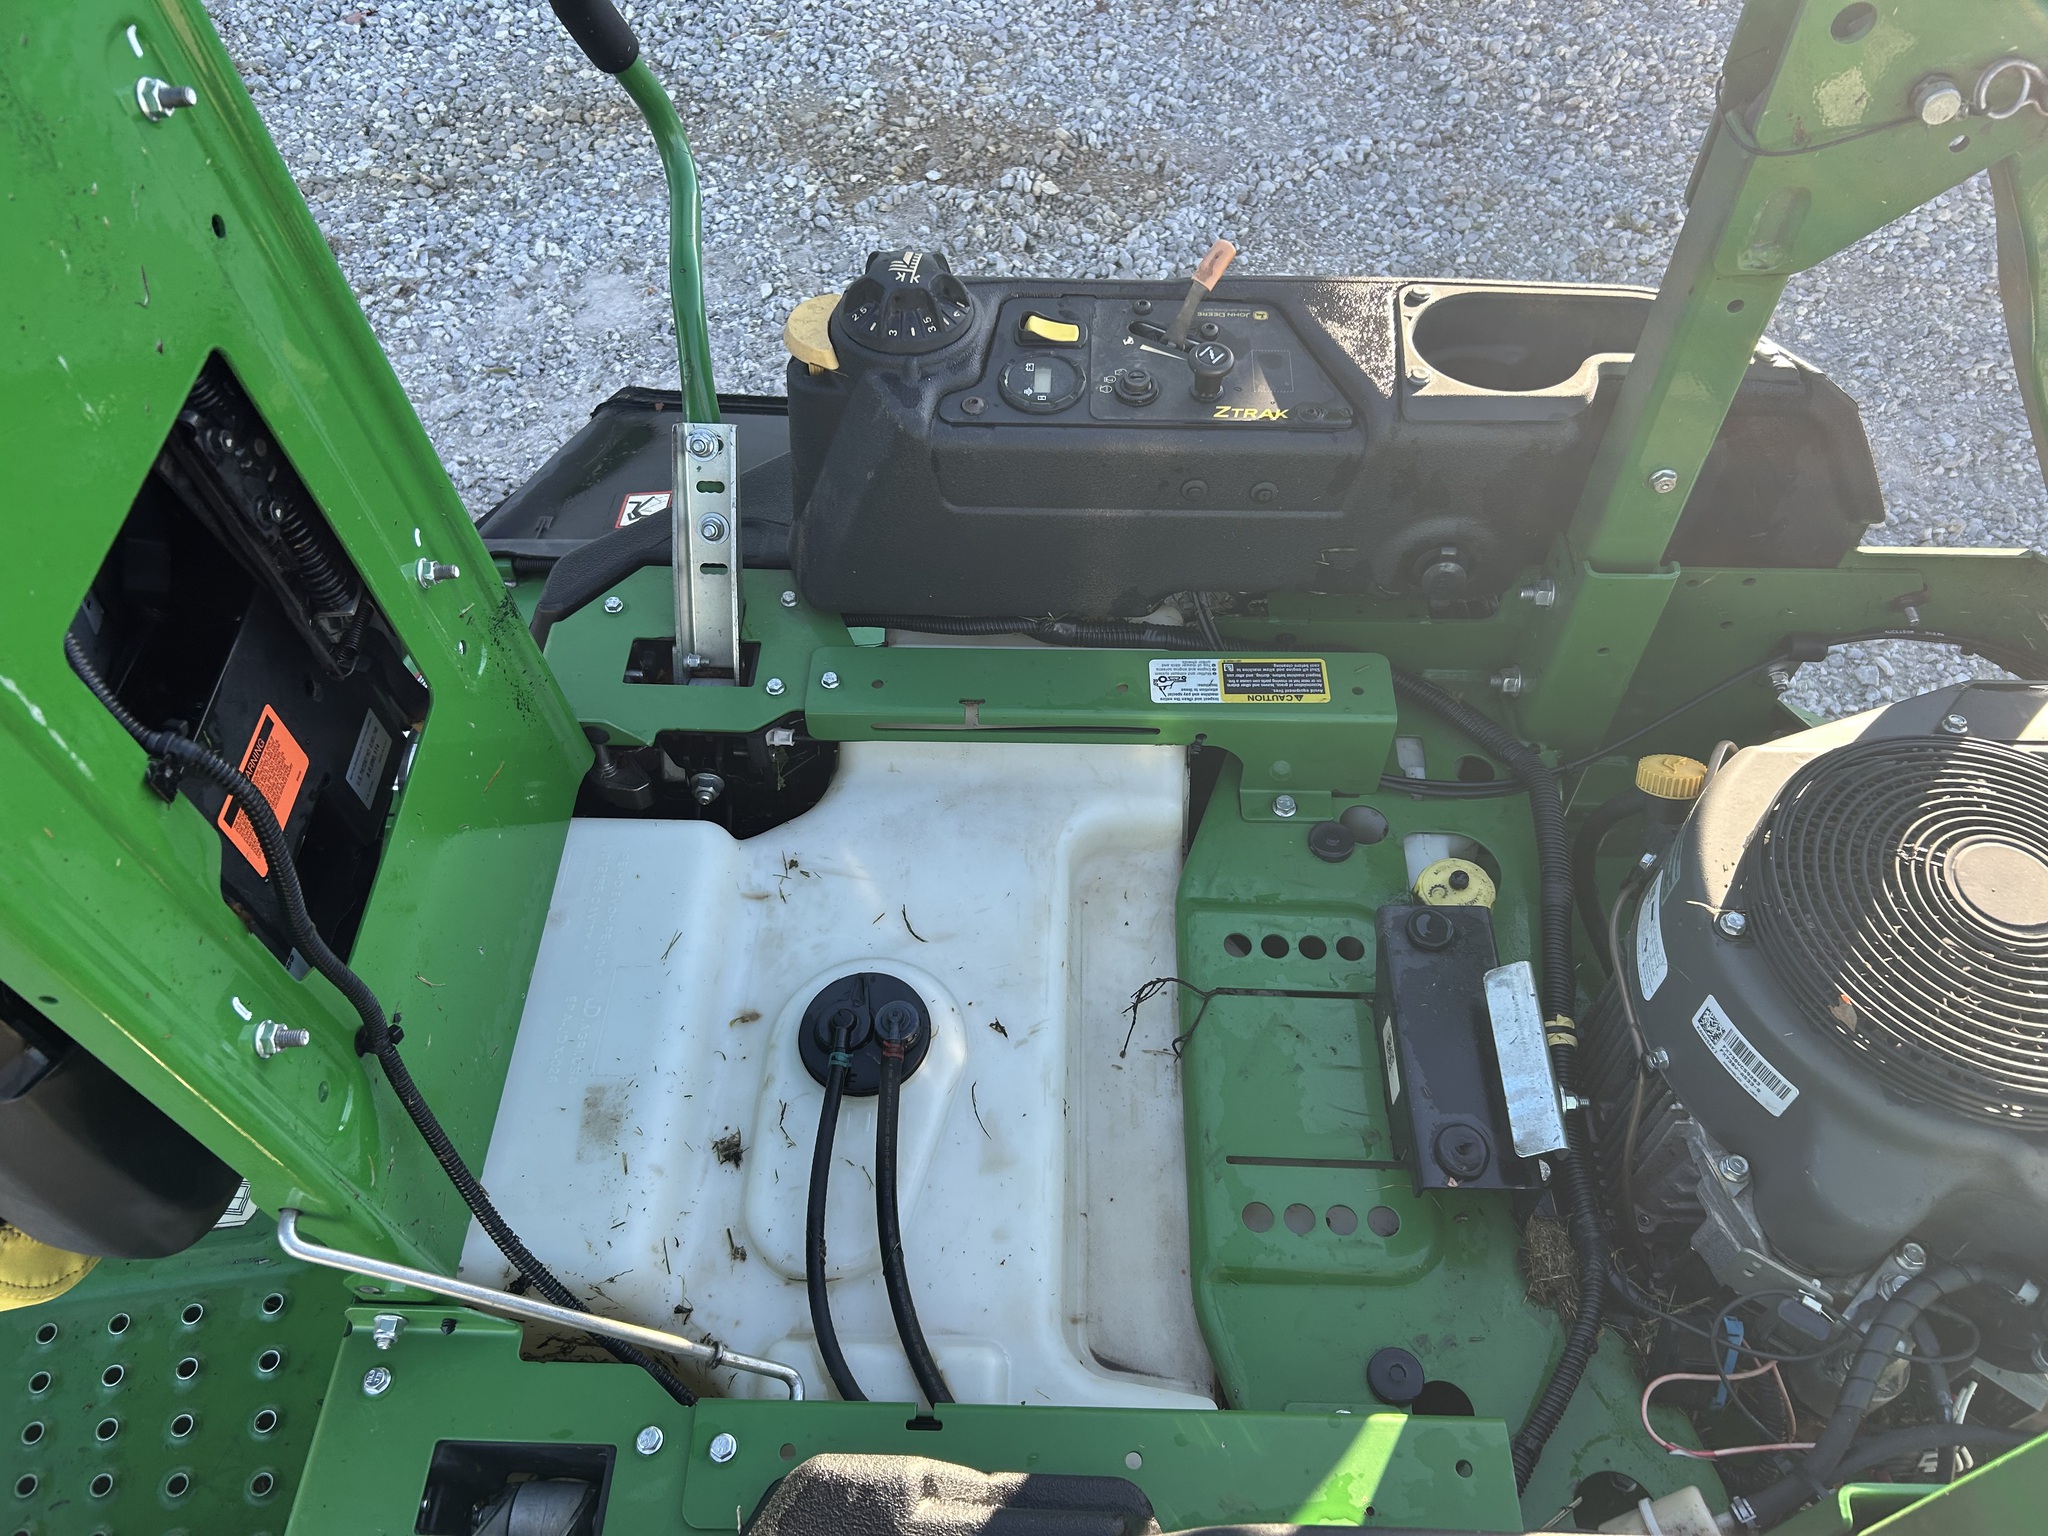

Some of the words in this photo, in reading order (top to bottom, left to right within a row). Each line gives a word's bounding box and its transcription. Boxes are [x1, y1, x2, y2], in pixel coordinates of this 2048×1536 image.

[852, 306, 867, 322] 2.5
[923, 316, 936, 333] 3.5
[1213, 406, 1289, 419] ZTRAK
[245, 738, 265, 780] ARNING
